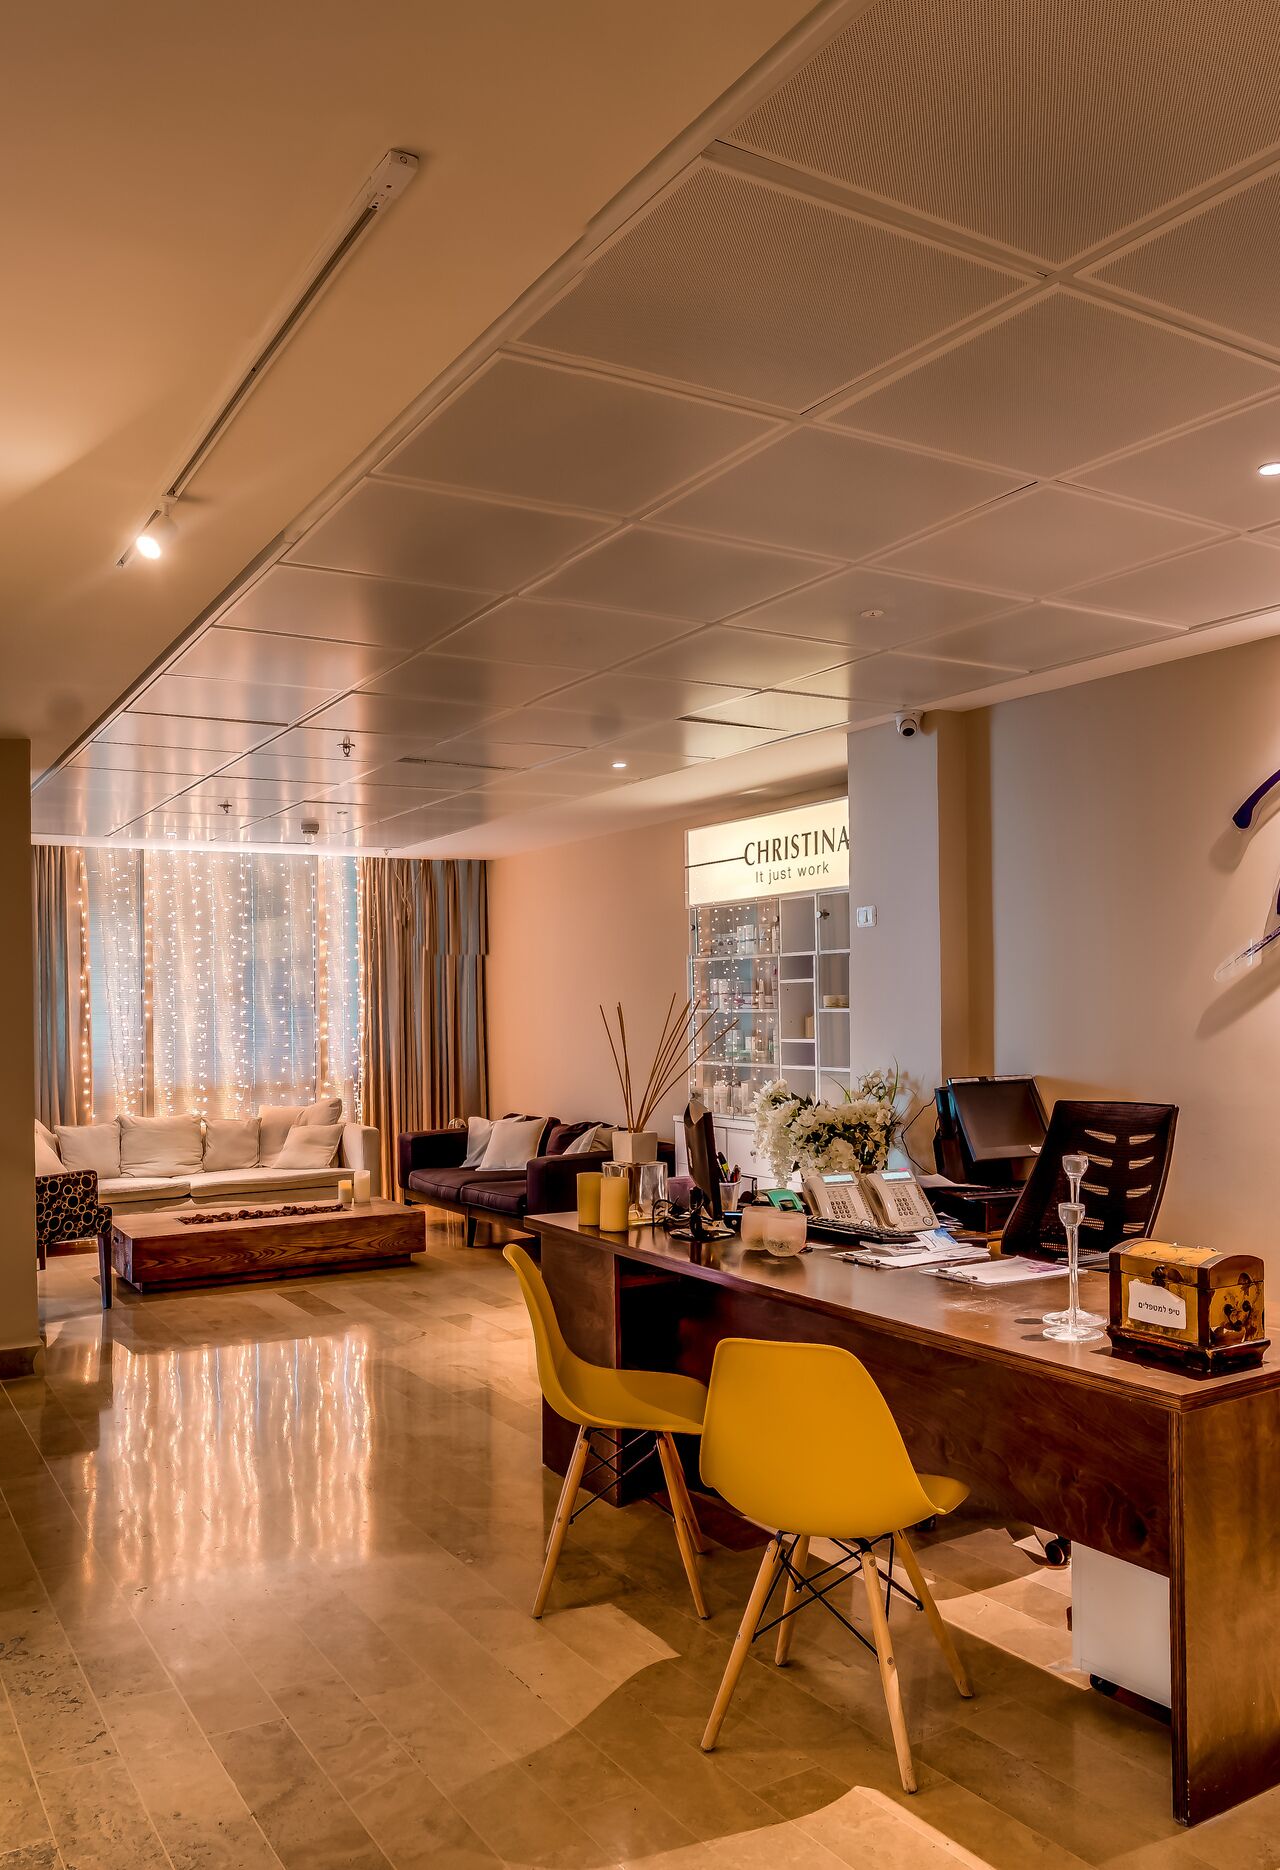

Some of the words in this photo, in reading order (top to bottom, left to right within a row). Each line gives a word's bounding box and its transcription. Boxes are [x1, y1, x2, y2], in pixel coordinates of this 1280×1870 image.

[744, 825, 850, 867] CHRISTINA
[755, 871, 764, 883] It
[768, 866, 792, 885] just
[797, 861, 829, 877] work
[1138, 1301, 1167, 1313] למטפלים
[1168, 1307, 1180, 1316] טיפ
